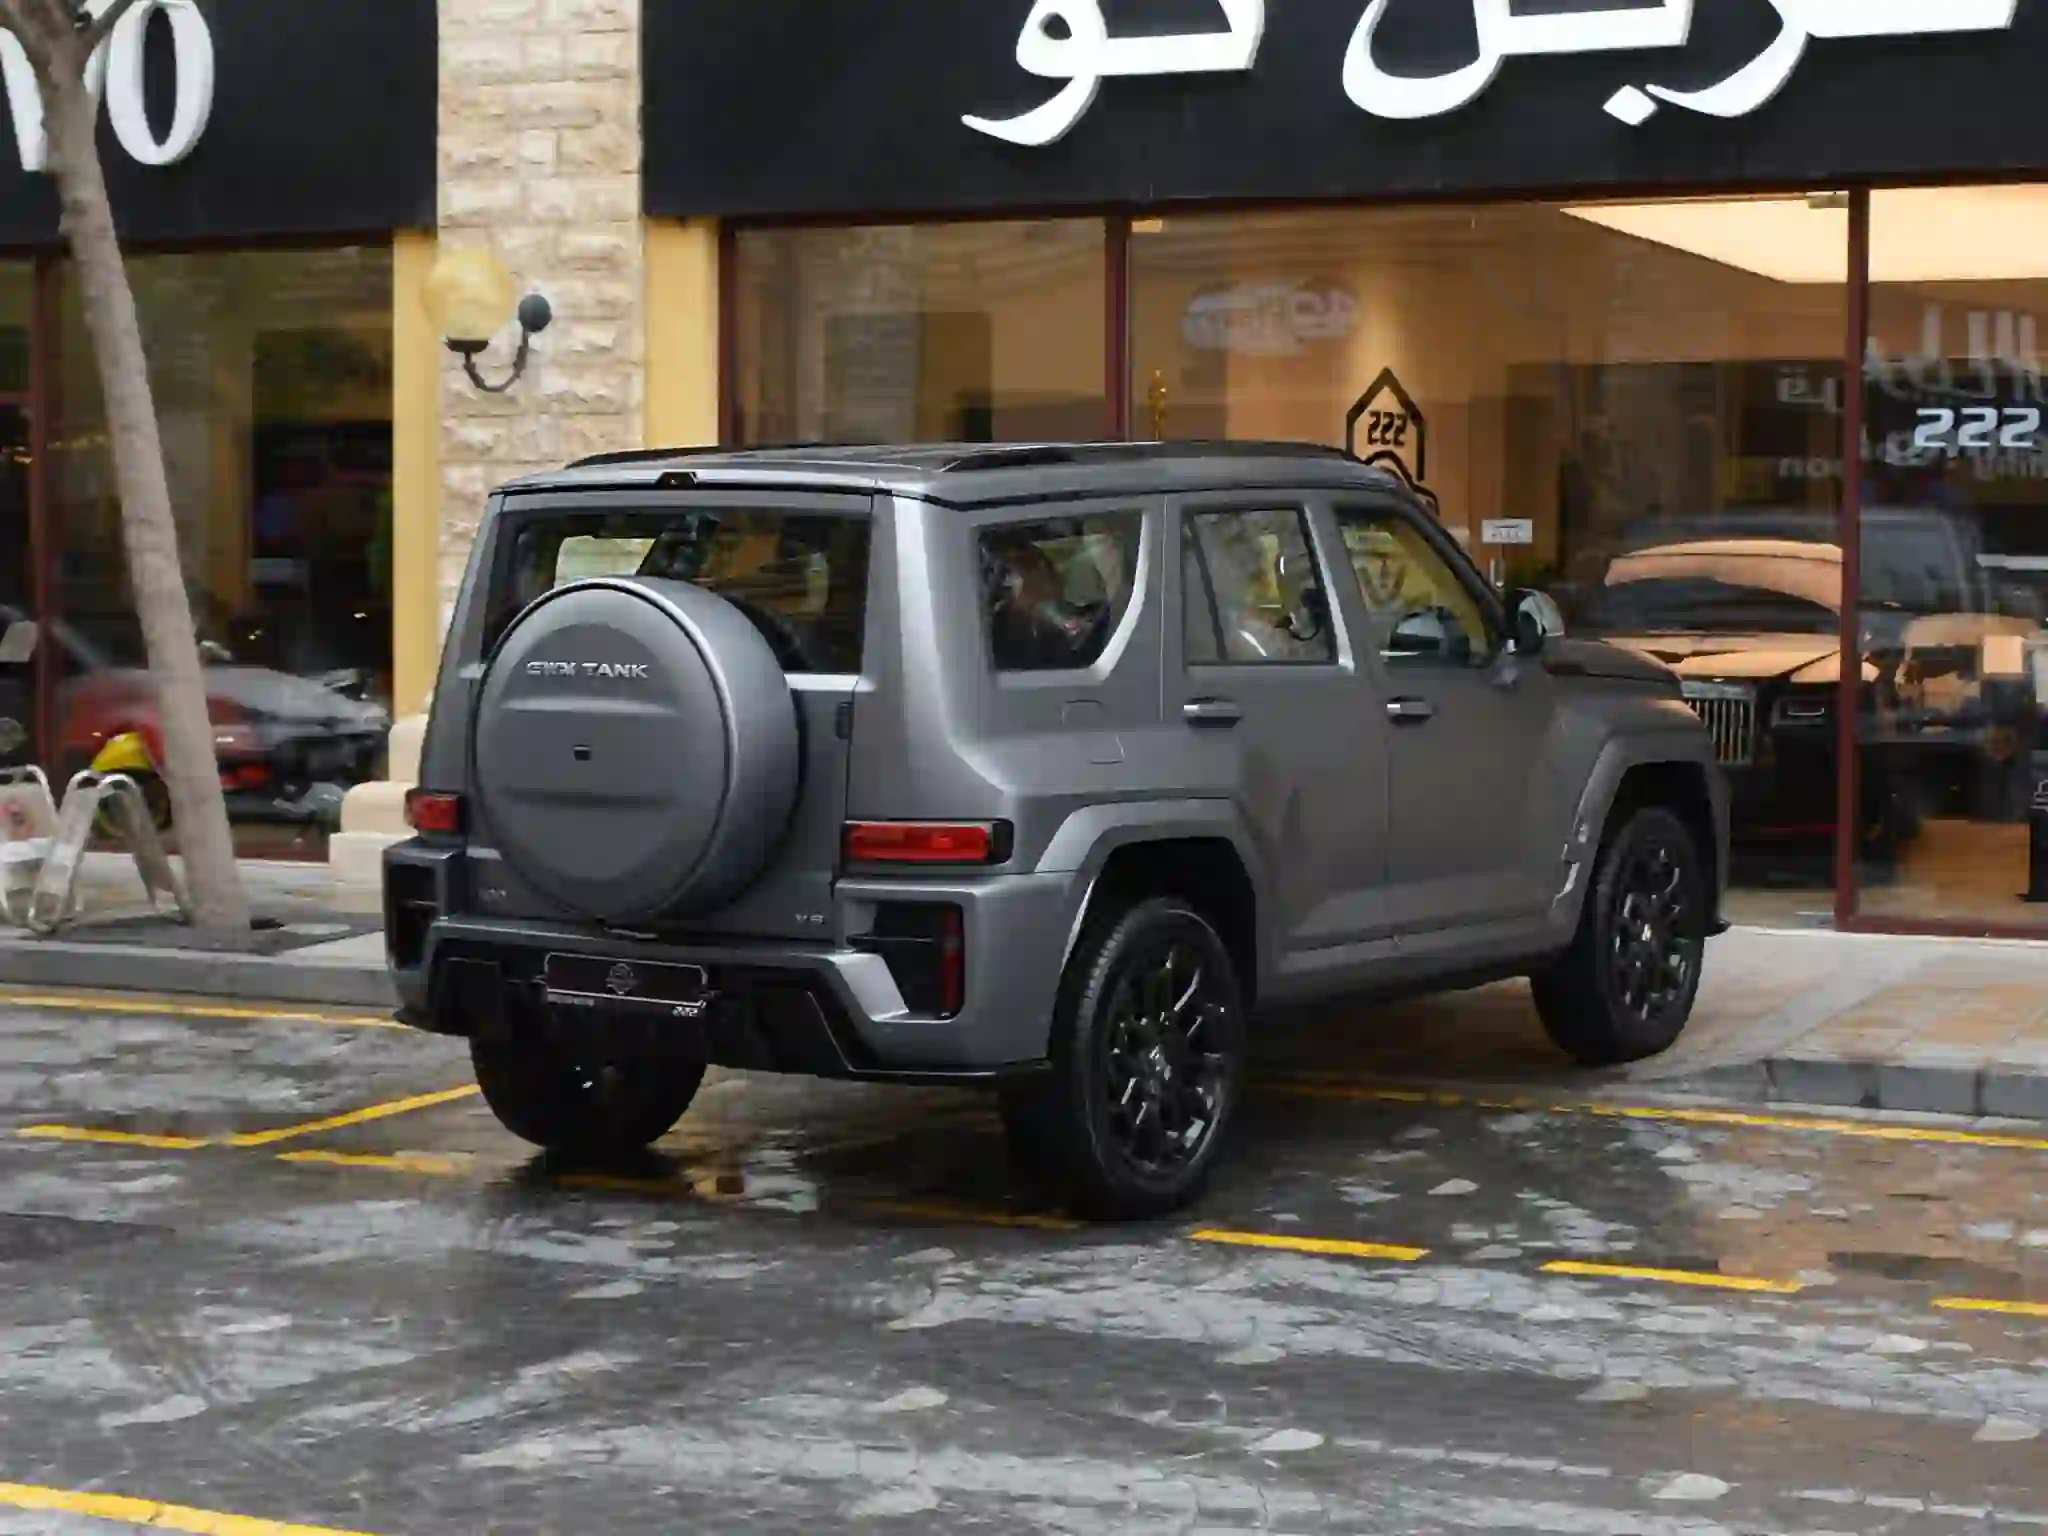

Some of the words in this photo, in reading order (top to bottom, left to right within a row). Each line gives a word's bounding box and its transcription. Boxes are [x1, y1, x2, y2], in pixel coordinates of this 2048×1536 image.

[1367, 411, 1408, 446] 222
[1914, 407, 2041, 447] 222
[582, 662, 649, 679] TANK
